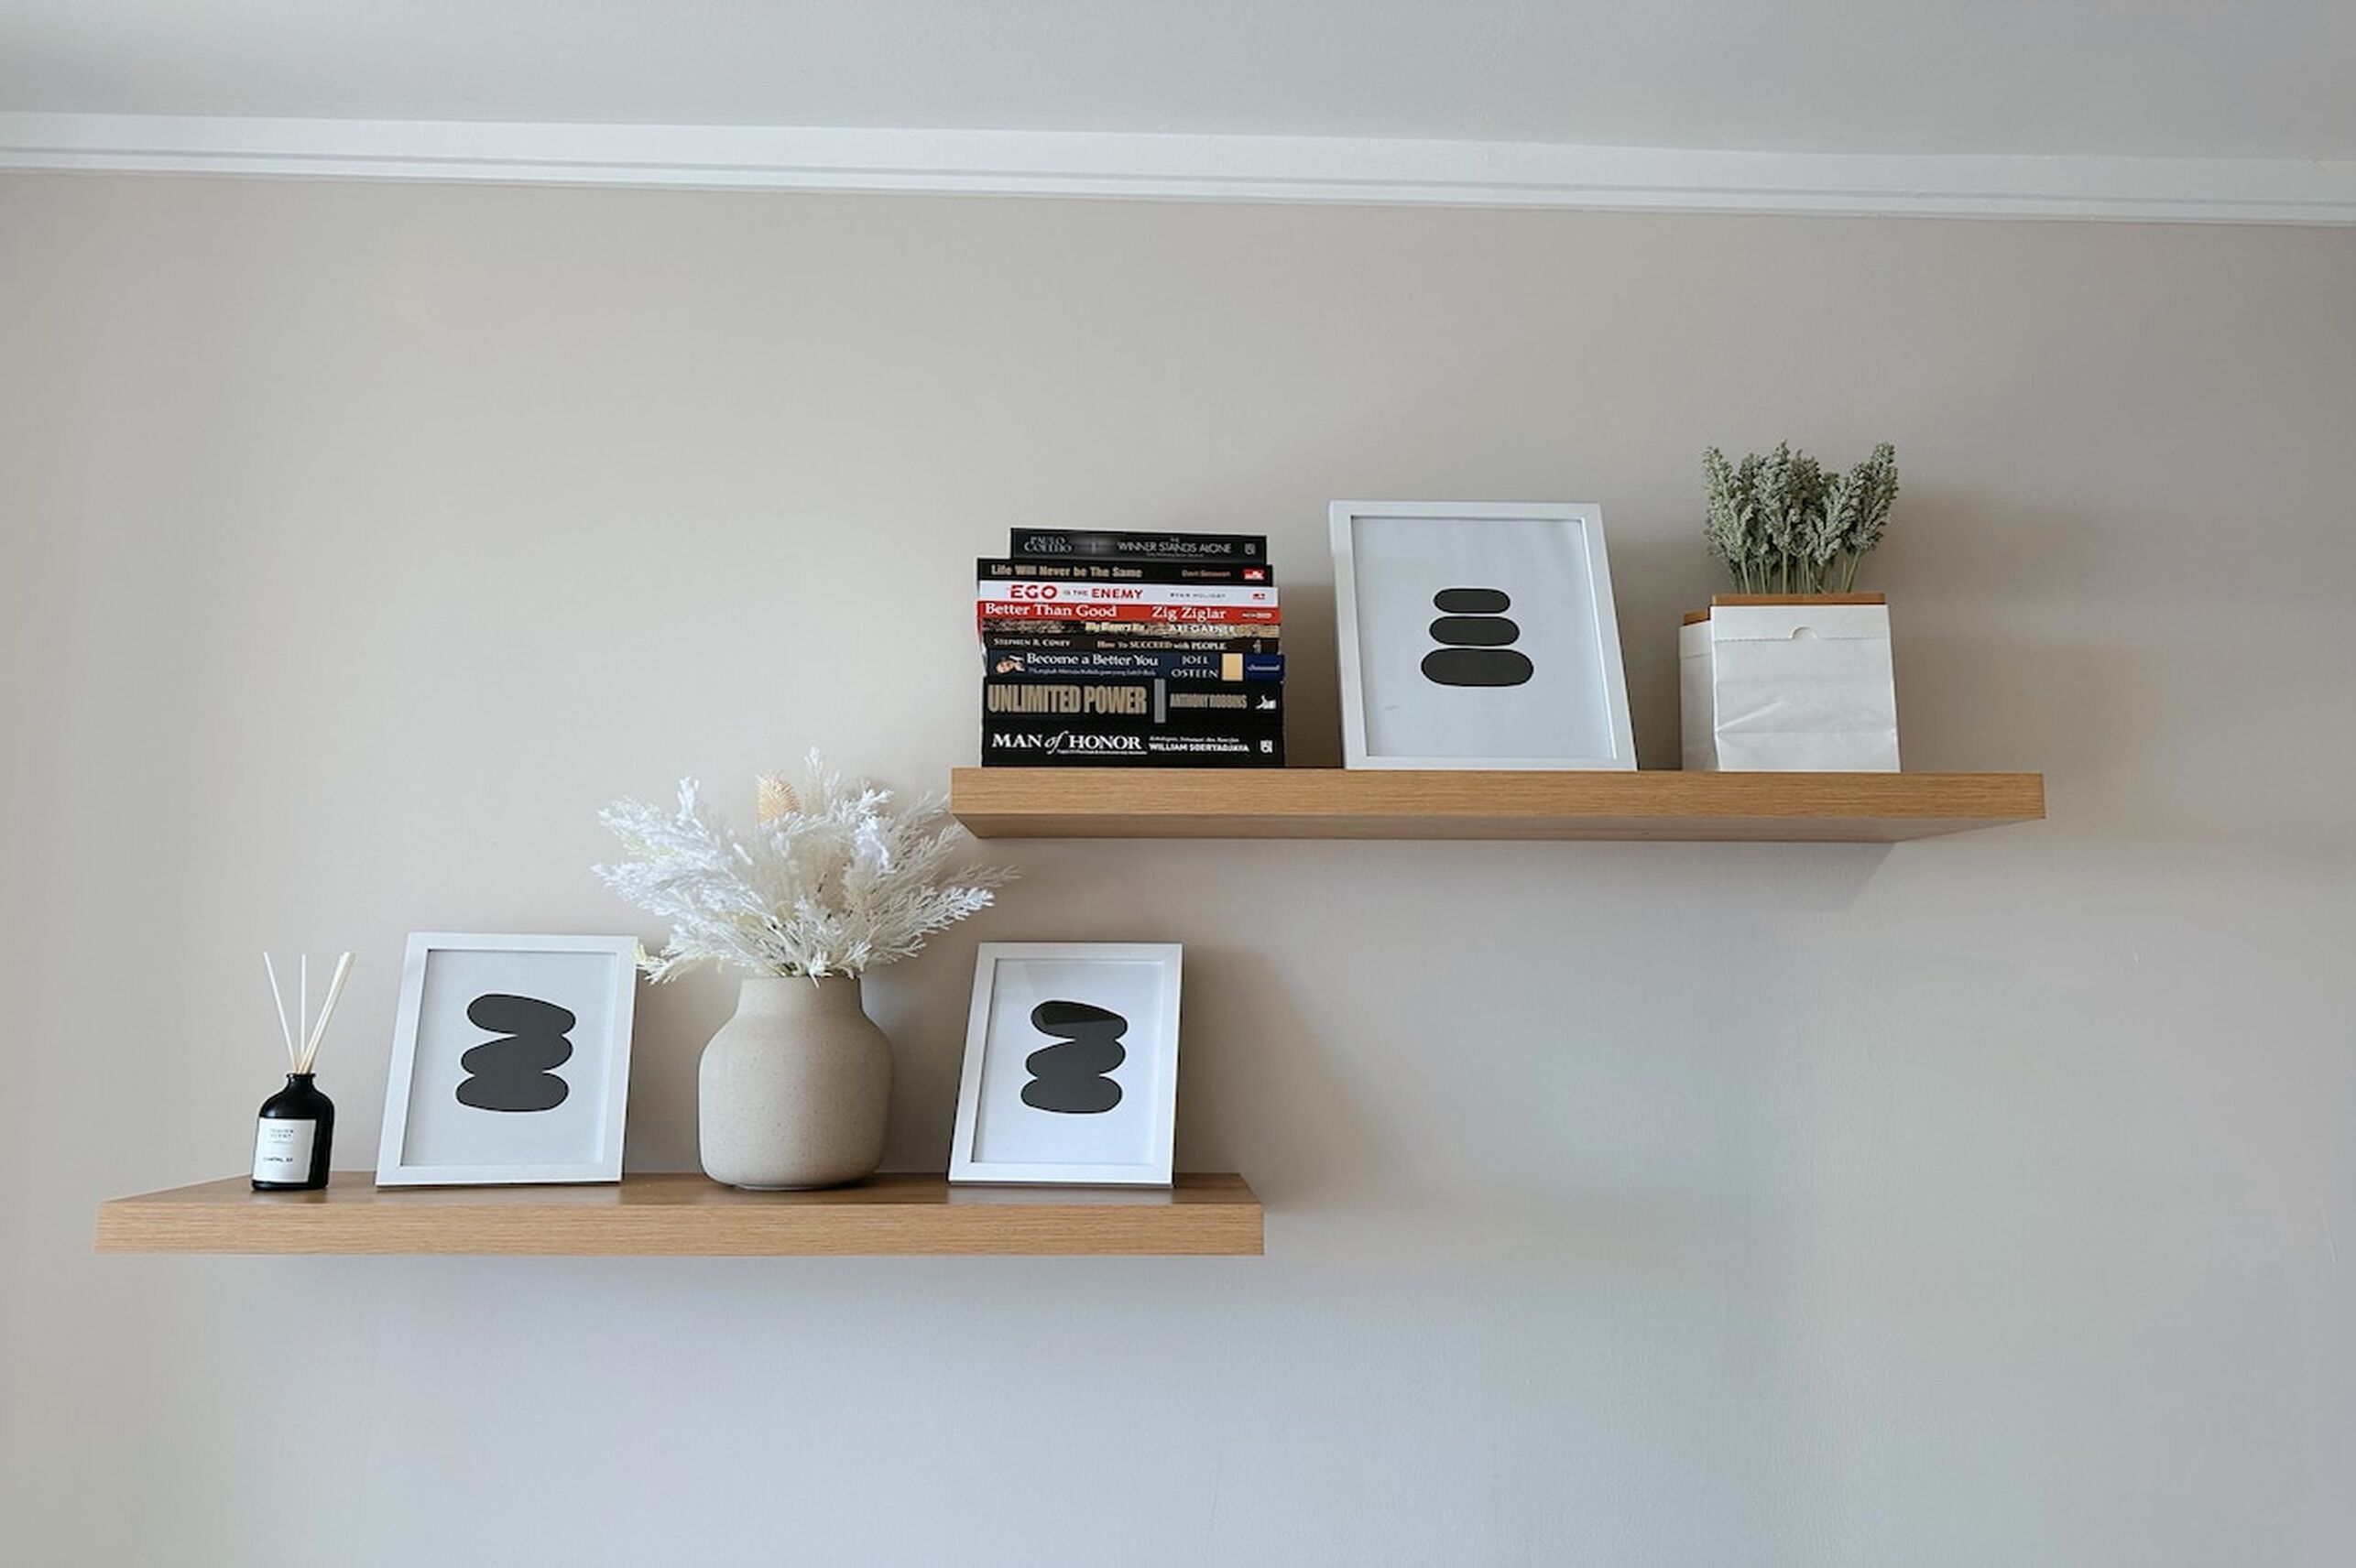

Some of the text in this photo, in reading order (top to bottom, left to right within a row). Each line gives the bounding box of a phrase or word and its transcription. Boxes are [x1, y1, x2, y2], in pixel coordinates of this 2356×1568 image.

[1116, 541, 1232, 553] WINNER STANDS ALONE
[990, 564, 1143, 578] Life Will Never be The Same
[1010, 584, 1057, 599] EGO
[1092, 588, 1143, 599] ENEMY
[986, 603, 1118, 617] Better Than Good
[1151, 606, 1178, 622] Zig
[1182, 607, 1227, 622] Ziglar
[993, 638, 1031, 647] STEPHEN
[1027, 653, 1159, 667] Become a Better You
[1181, 656, 1209, 665] JOEL
[1171, 669, 1219, 679] OSTEEN
[987, 684, 1147, 714] UNLIMITED POWER
[1170, 693, 1208, 708] ANTHONY
[991, 734, 1042, 748] MAN
[1044, 730, 1069, 755] of
[1069, 735, 1142, 749] HONOR
[1149, 743, 1188, 751] WILLIAM
